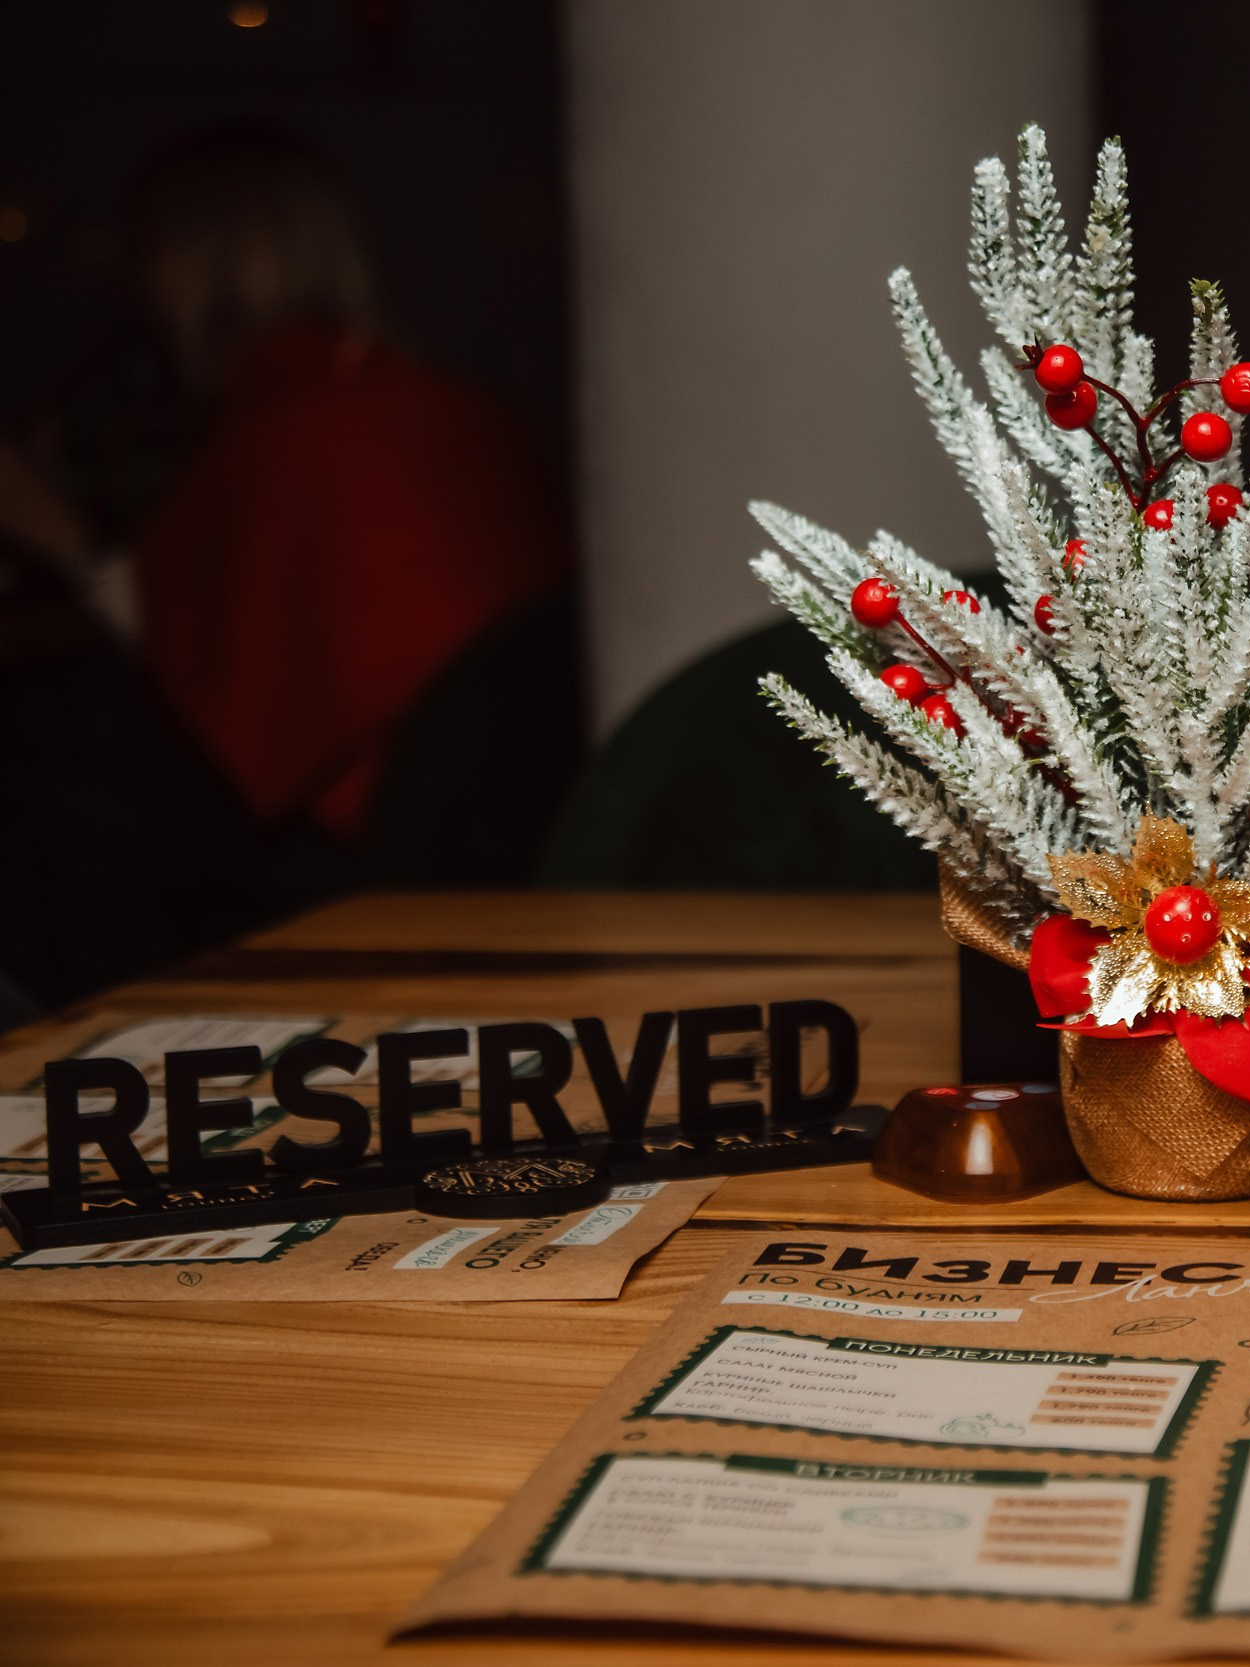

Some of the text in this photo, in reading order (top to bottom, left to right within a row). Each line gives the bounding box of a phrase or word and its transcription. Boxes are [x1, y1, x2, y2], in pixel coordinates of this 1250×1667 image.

[45, 999, 860, 1195] RESERVED
[465, 1231, 544, 1269] ВАШЕГО
[752, 1242, 1246, 1285] БИЗНЕС
[738, 1272, 982, 1303] По будням
[779, 1294, 860, 1311] 12:00
[865, 1308, 904, 1317] до
[918, 1310, 998, 1319] 15:00
[731, 1345, 898, 1370] СЫРНЫЙ КРЕМ-СУП
[844, 1339, 1098, 1365] ПОНЕДЕЛЬНИК
[702, 1372, 783, 1387] КУРИНЫЕ
[716, 1359, 858, 1380] САЛАТ МЯСНОЙ
[795, 1463, 976, 1484] ВТОРНИК
